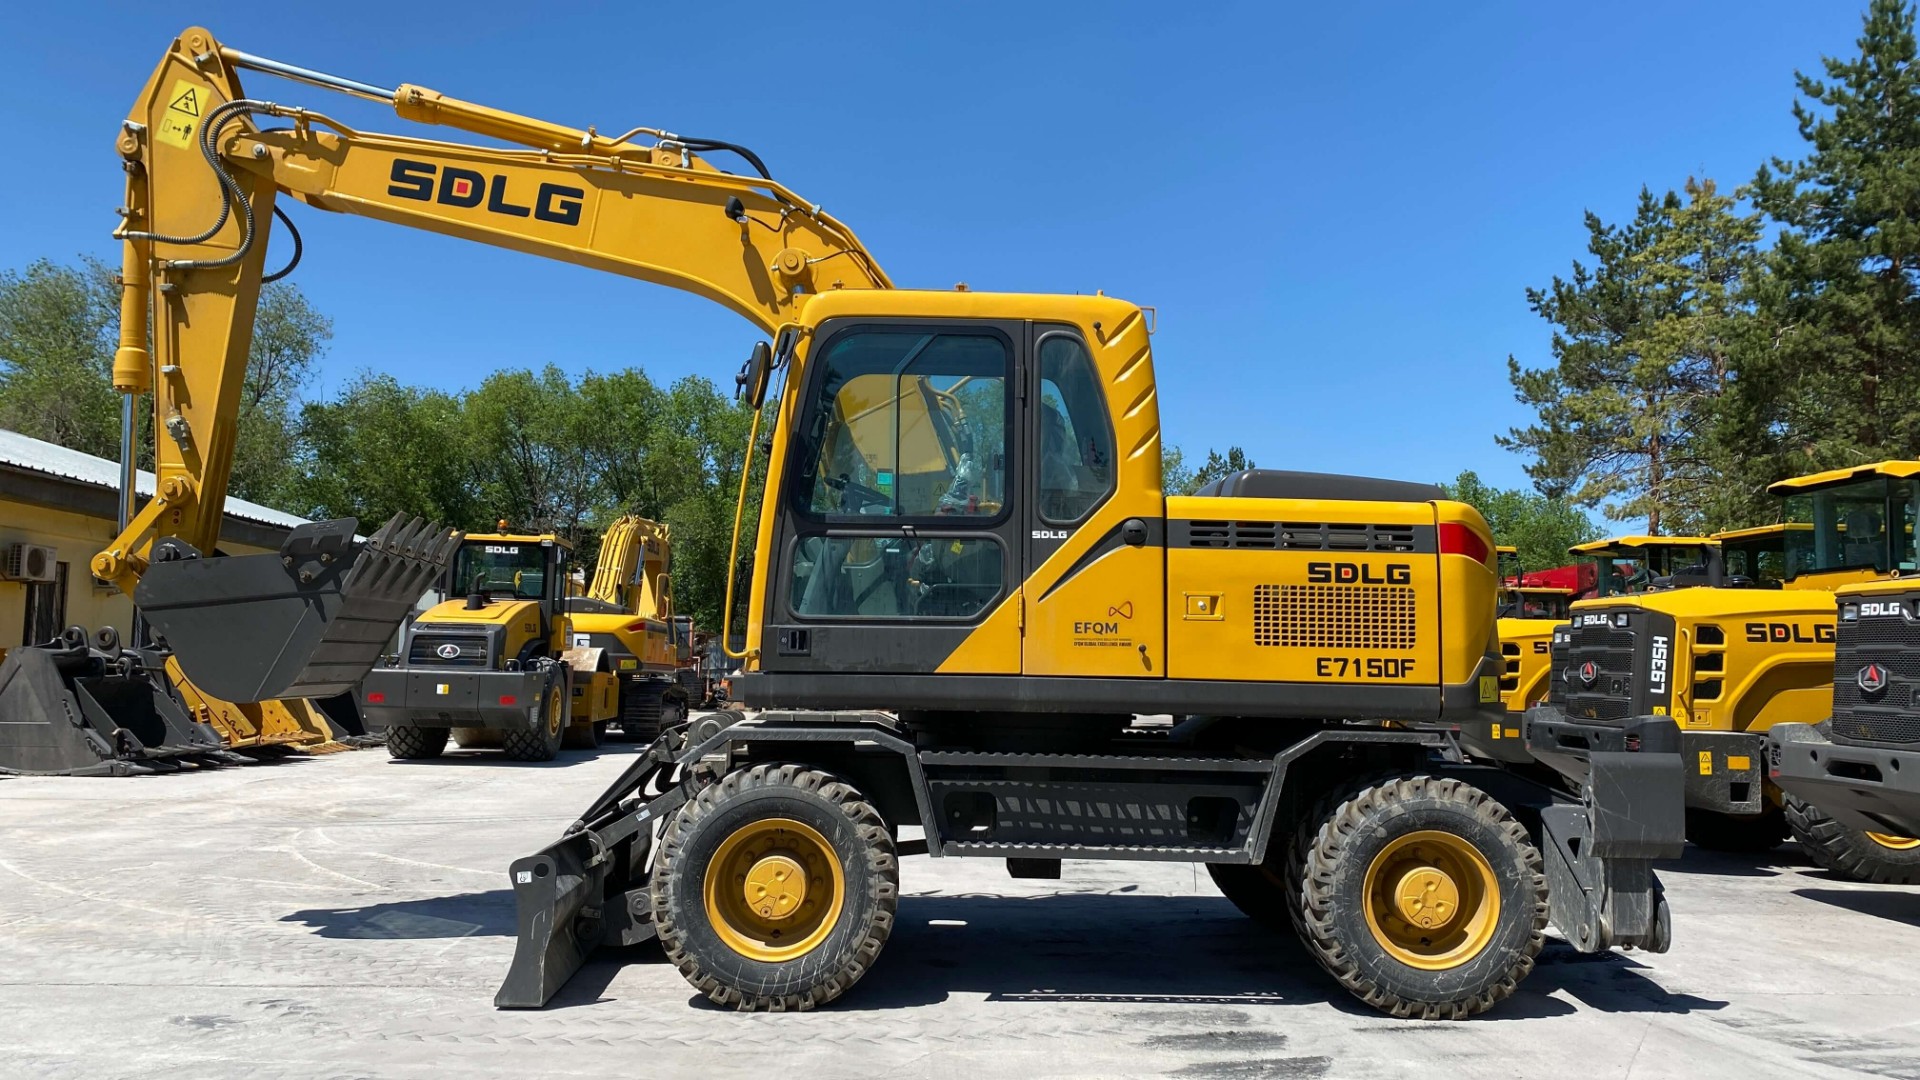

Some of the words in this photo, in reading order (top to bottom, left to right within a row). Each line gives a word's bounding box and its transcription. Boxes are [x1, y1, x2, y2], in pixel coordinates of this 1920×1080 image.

[388, 158, 585, 226] SDLG
[1031, 530, 1068, 539] SDLG
[485, 545, 519, 554] SDLG
[1308, 562, 1411, 585] SDLG
[1860, 602, 1900, 616] SDLG
[1583, 613, 1608, 625] SDLG
[1074, 622, 1118, 635] EFQM
[1745, 623, 1836, 643] SDLG
[1316, 658, 1416, 678] E7150F
[1650, 635, 1668, 694] L935H
